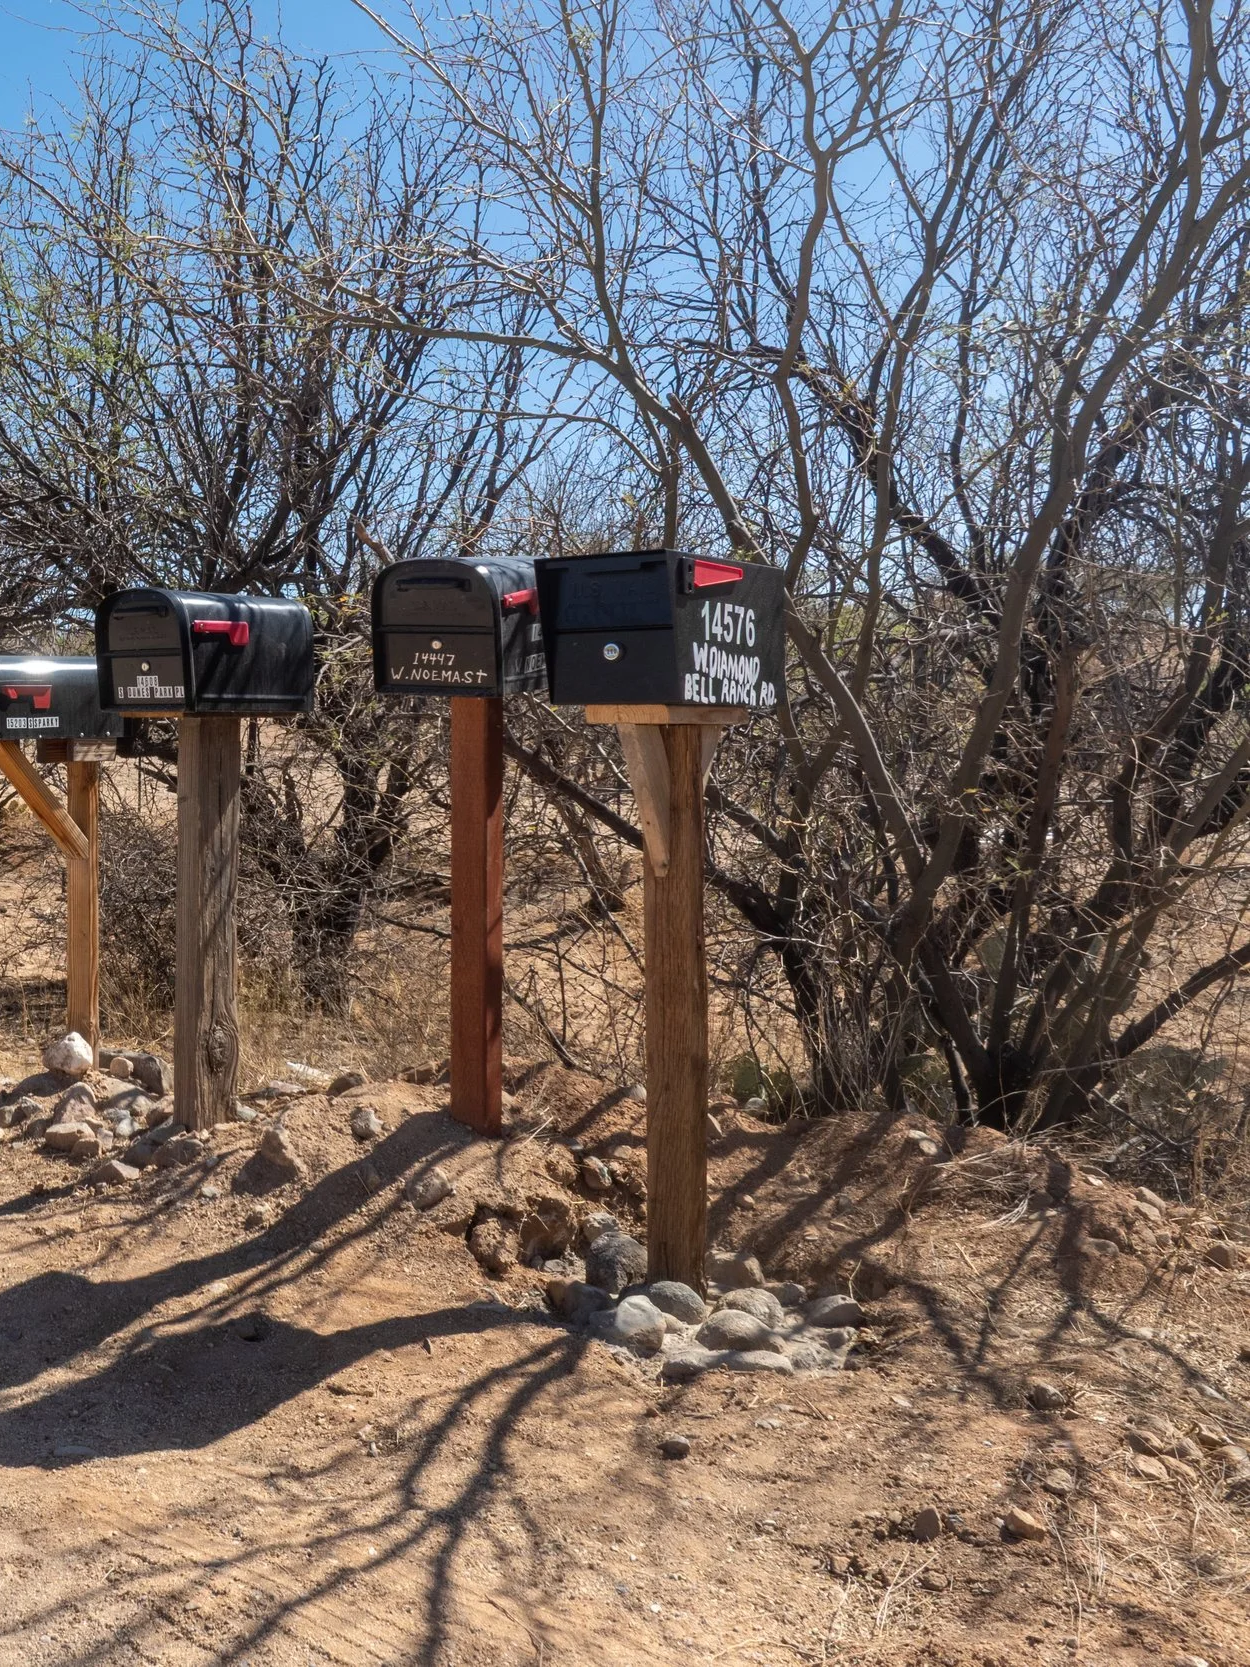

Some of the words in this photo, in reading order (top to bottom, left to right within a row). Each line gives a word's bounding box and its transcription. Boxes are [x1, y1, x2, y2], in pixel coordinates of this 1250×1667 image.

[701, 600, 755, 647] 14576
[412, 652, 455, 666] 14447
[154, 687, 173, 697] PARK
[175, 687, 184, 697] PL
[684, 673, 716, 704] BELL
[7, 718, 26, 728] 15203
